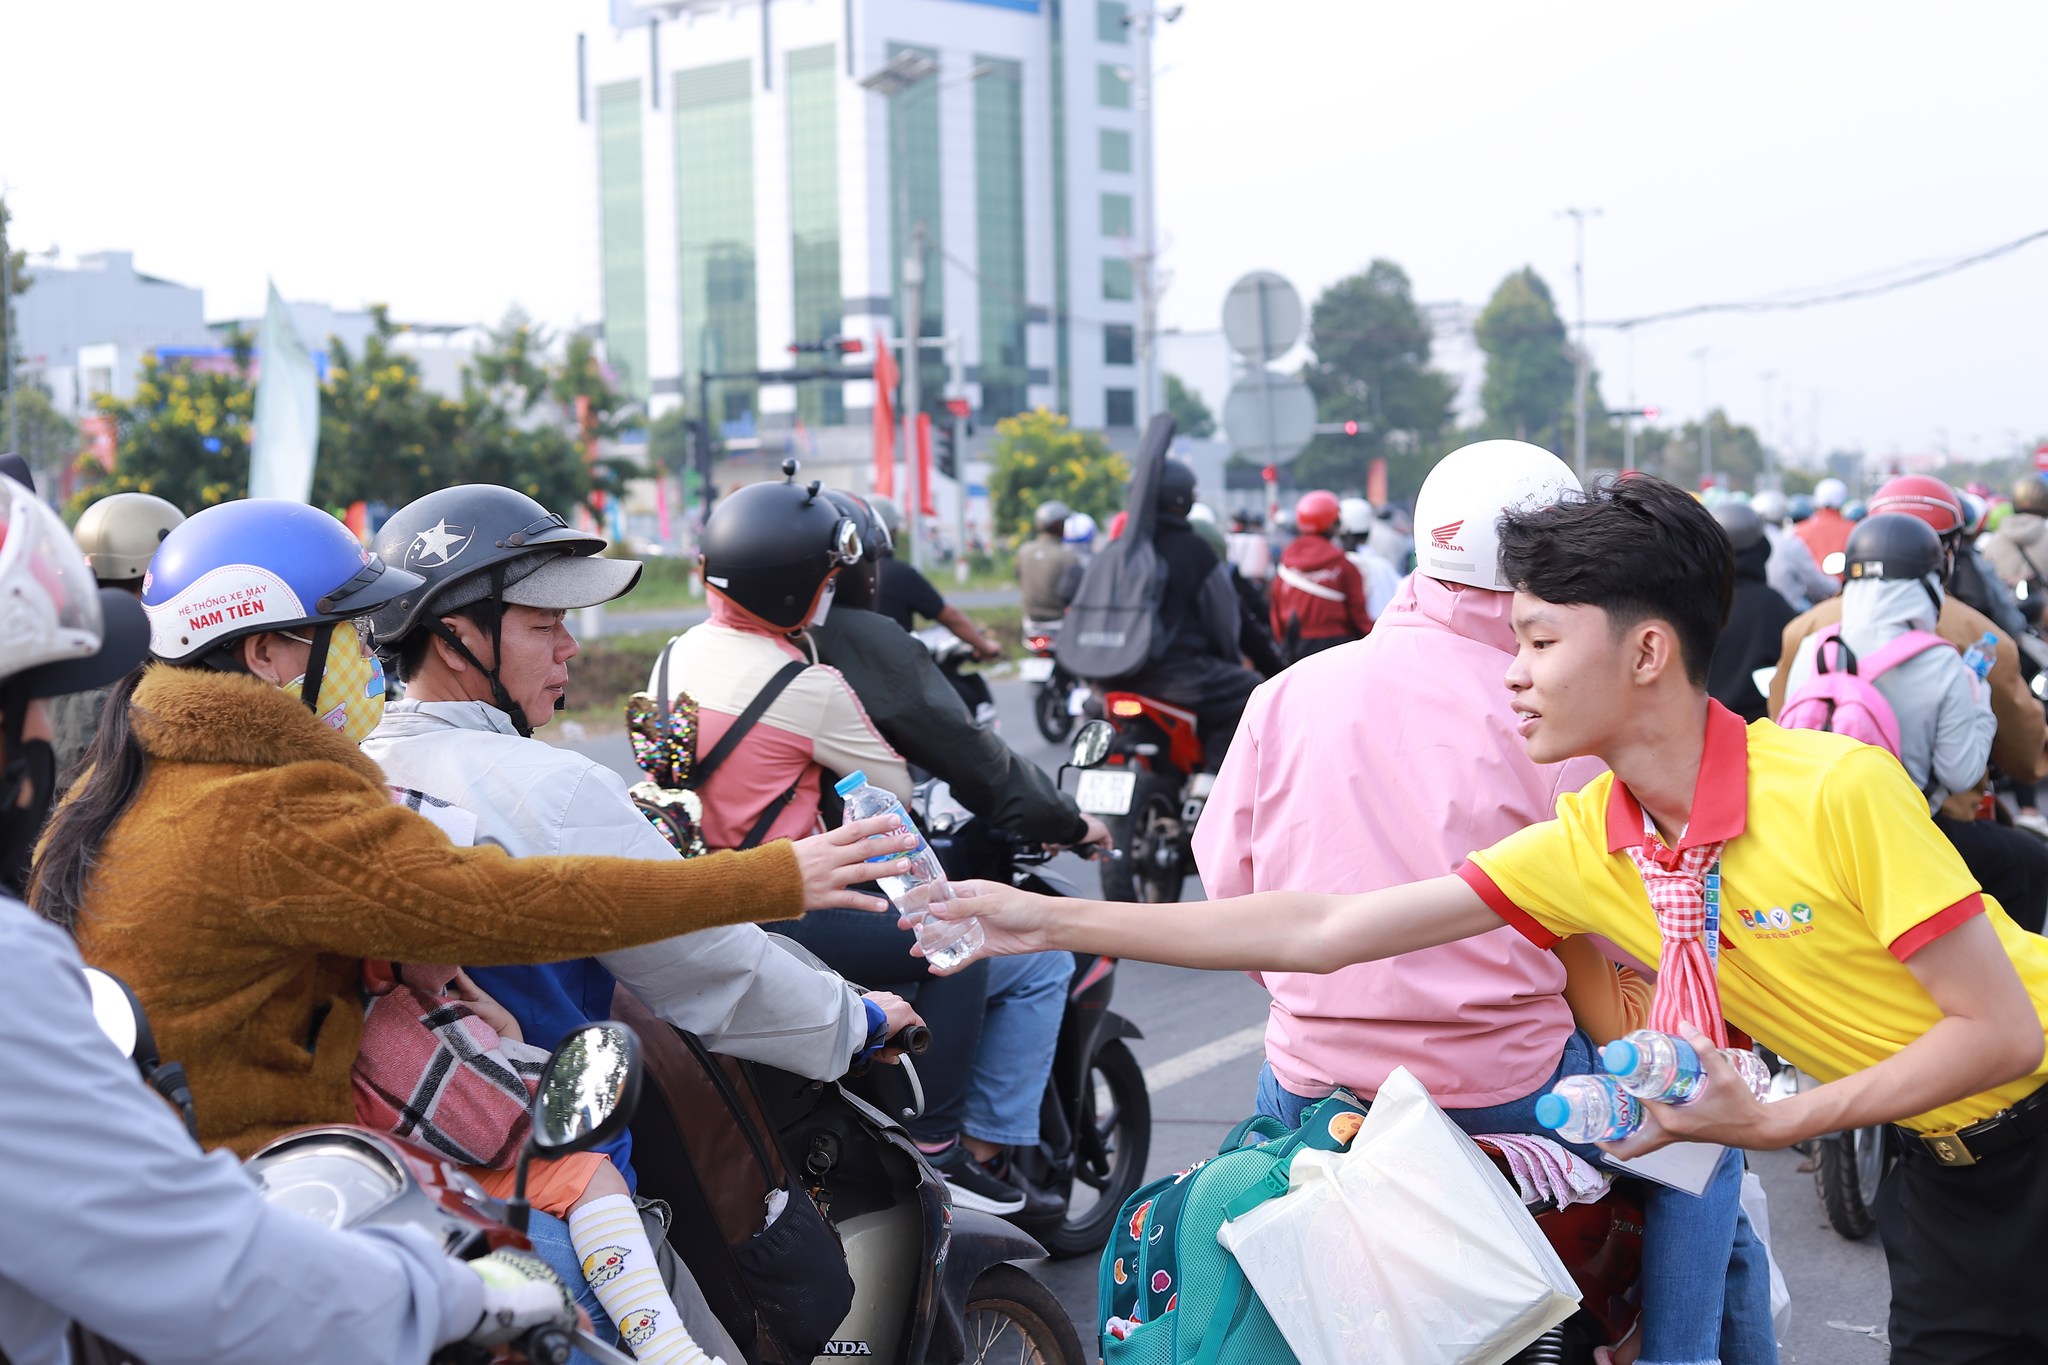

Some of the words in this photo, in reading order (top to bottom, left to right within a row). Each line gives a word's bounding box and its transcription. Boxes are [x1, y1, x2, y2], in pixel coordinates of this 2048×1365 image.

[1431, 541, 1465, 552] HONDA
[178, 605, 191, 617] HỆ
[192, 595, 227, 611] THỐNG
[229, 591, 244, 602] XE
[245, 584, 267, 598] MÁY
[189, 610, 224, 631] NAM
[226, 597, 265, 620] TIẾN
[1708, 932, 1717, 949] JCI
[823, 1341, 872, 1355] NDA
